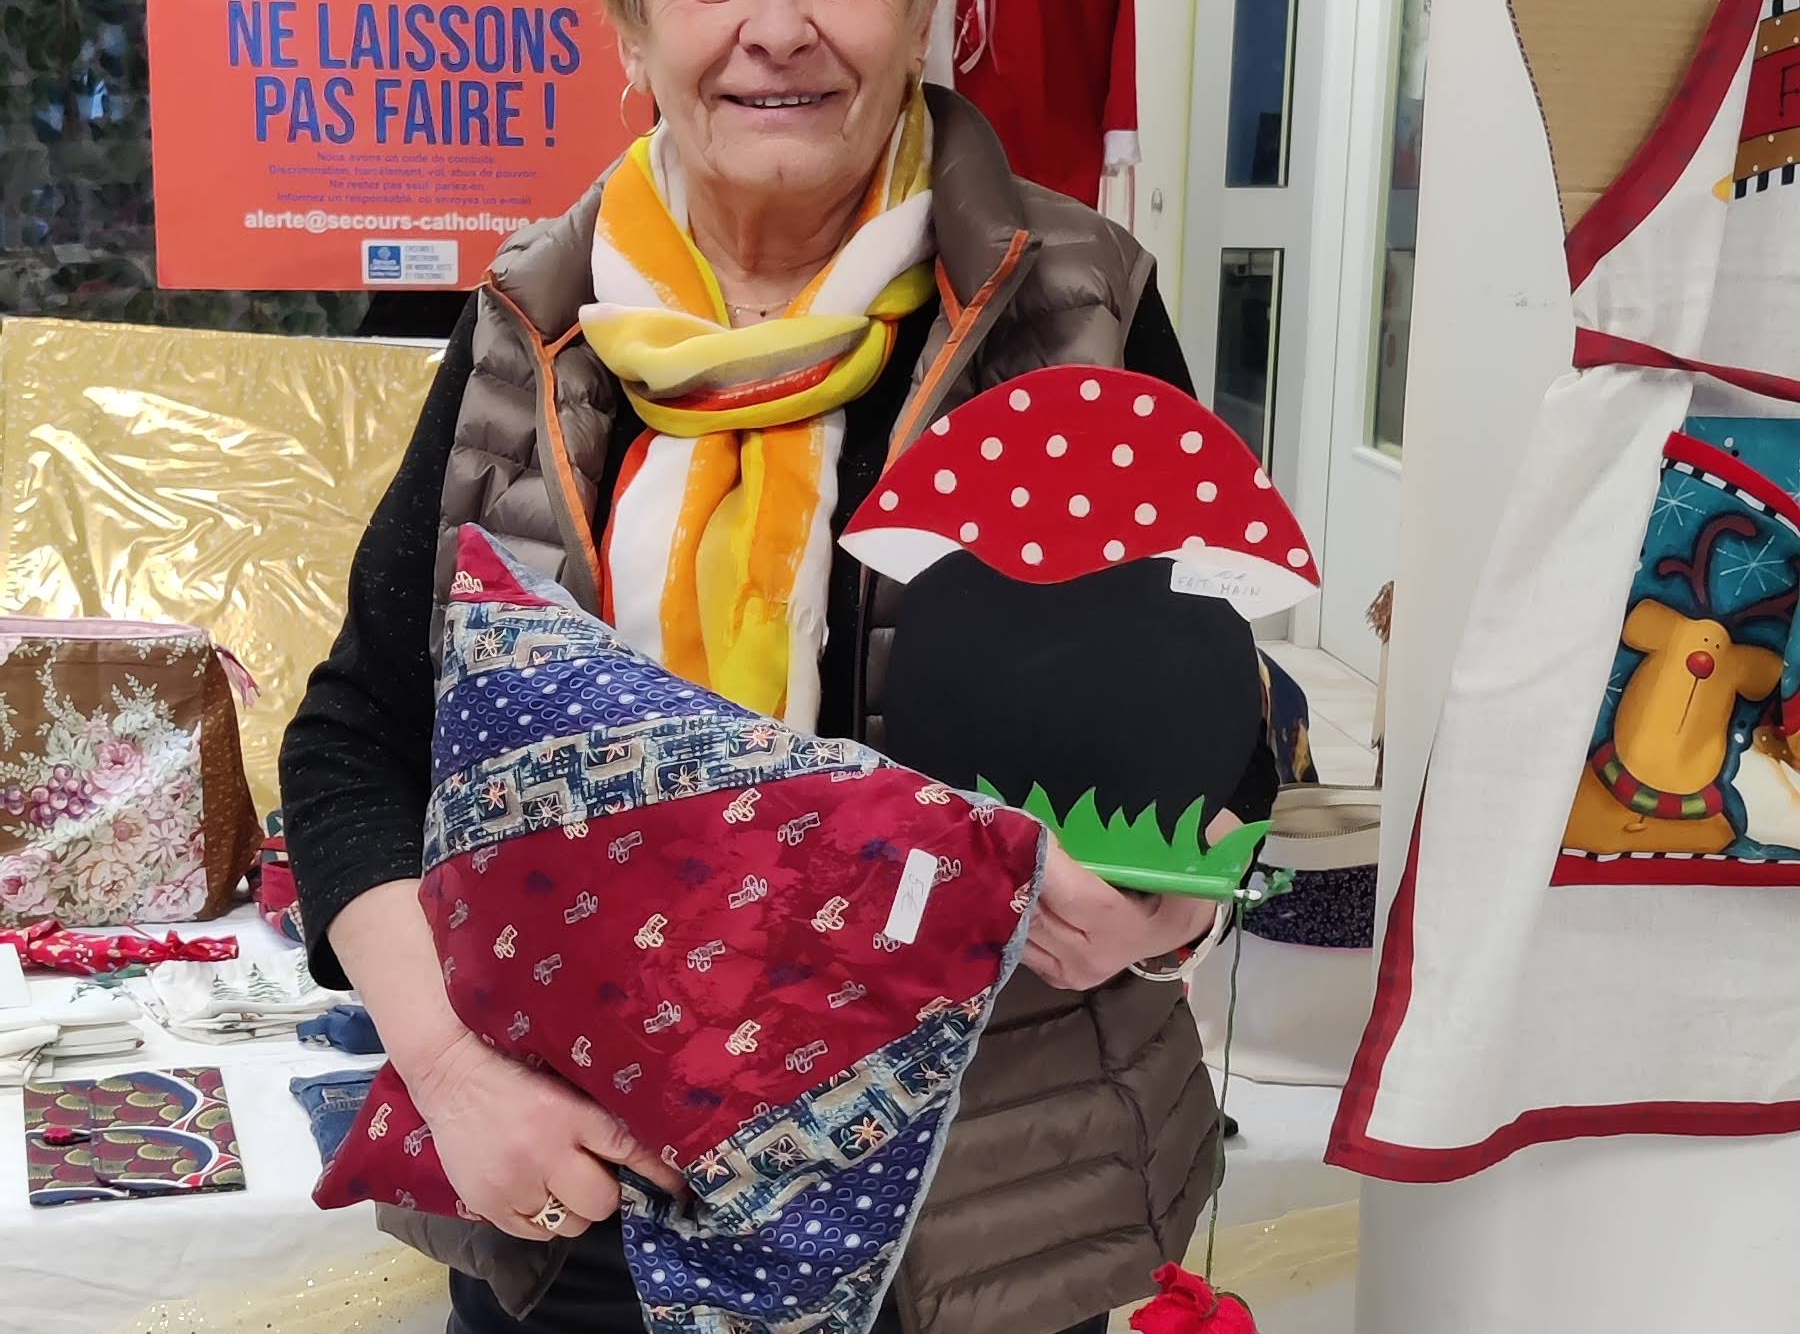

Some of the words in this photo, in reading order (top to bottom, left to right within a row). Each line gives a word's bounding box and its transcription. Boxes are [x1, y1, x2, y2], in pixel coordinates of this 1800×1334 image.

[228, 0, 298, 68] NE
[317, 3, 581, 76] LAISSONS
[254, 76, 356, 145] PAS
[375, 78, 525, 147] FAIRE
